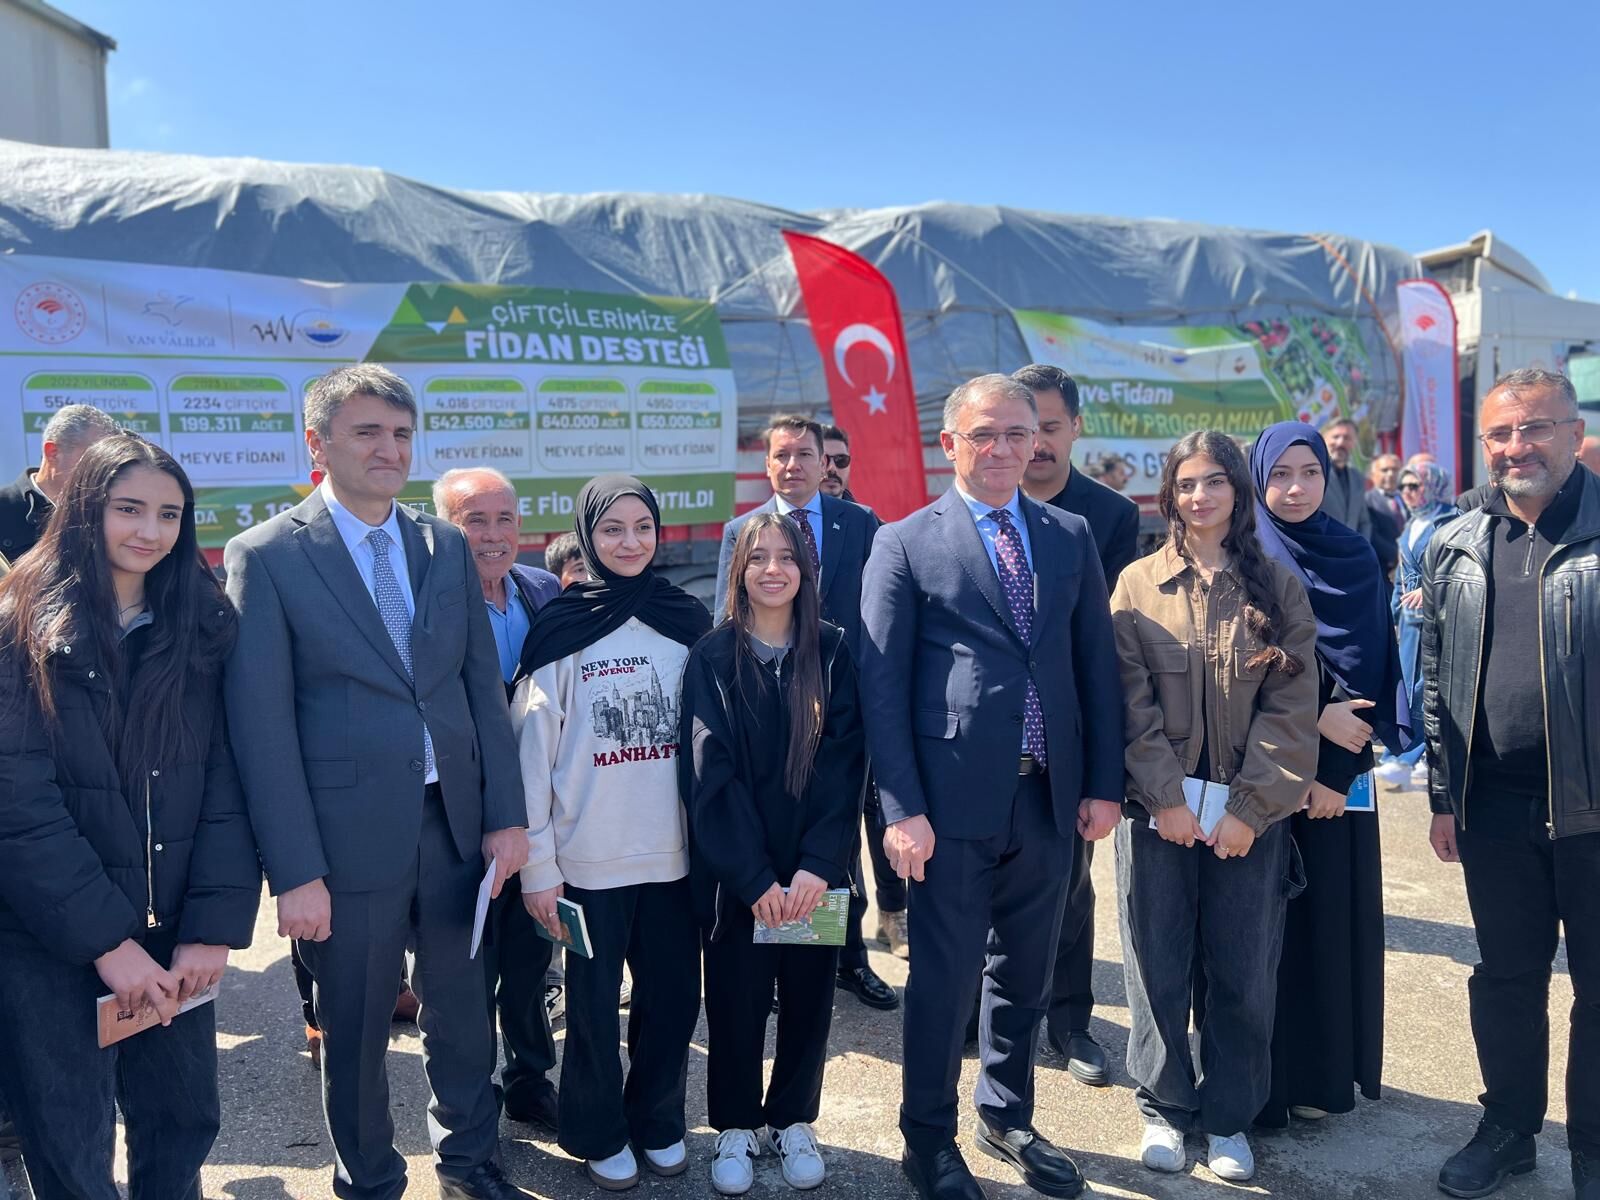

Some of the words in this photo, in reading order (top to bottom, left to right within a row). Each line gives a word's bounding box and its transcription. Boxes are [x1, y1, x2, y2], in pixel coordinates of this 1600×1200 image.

[491, 301, 679, 333] ÇİFTÇİLERİMİZE
[465, 324, 574, 361] FİDAN
[579, 334, 711, 367] DESTEĞİ
[183, 397, 221, 409] 2234
[180, 415, 241, 431] 199.311
[251, 420, 283, 431] ADET
[429, 415, 494, 430] 542.500
[497, 418, 525, 428] ADET
[1143, 410, 1275, 437] PROGRAMINA
[180, 452, 233, 465] MEYVE
[237, 447, 285, 464] FİDANI
[435, 446, 479, 459] MEYVE
[482, 443, 524, 458] FİDANI
[545, 445, 585, 457] MEYVE
[581, 659, 609, 675] NEW
[613, 656, 650, 668] YORK
[582, 671, 595, 682] 5TH
[598, 666, 636, 677] AVENUE
